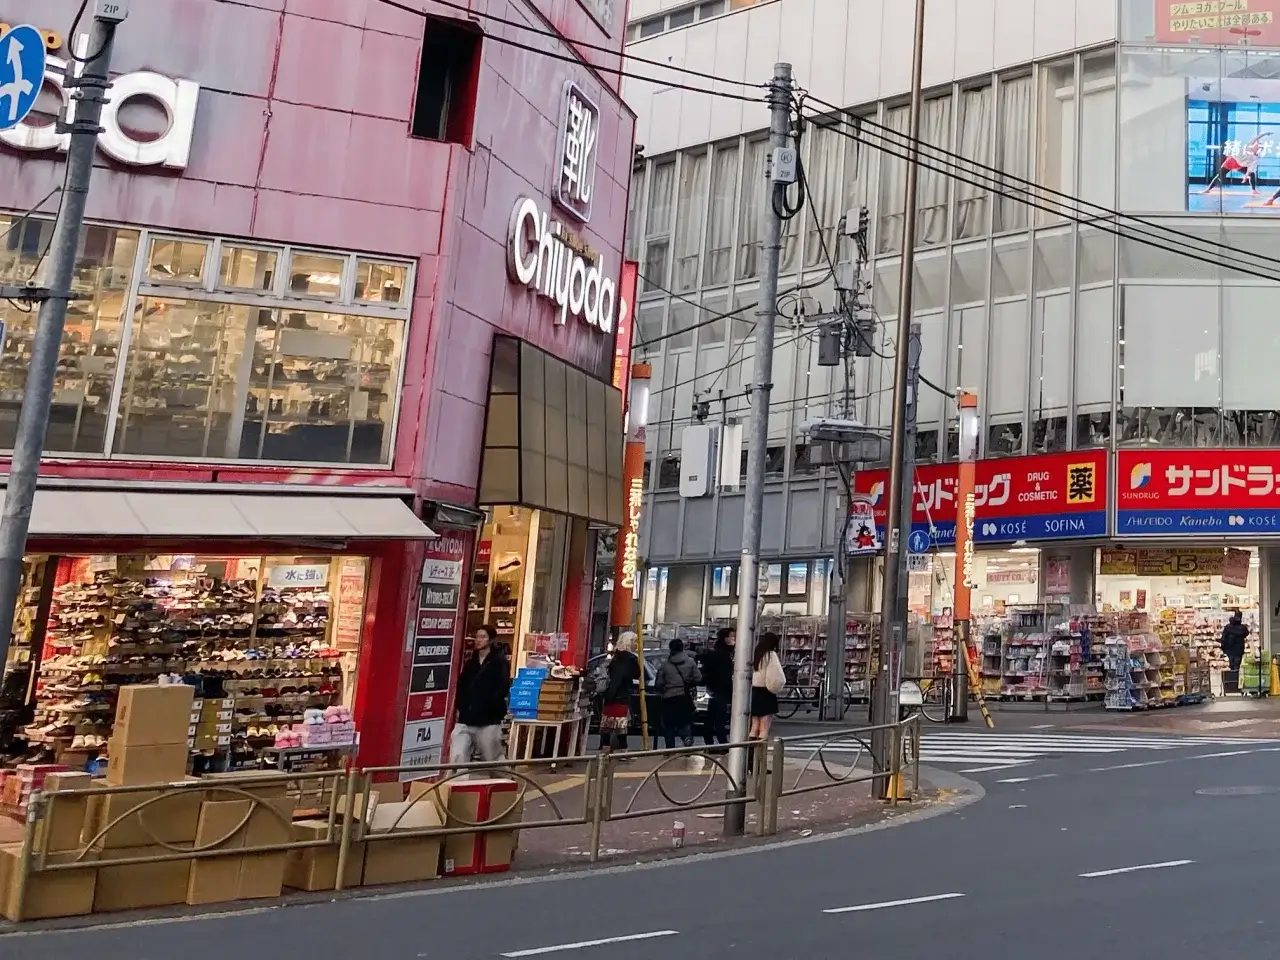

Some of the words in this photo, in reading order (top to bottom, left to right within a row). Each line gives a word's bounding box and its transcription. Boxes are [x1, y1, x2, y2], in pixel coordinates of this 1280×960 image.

[103, 3, 119, 14] ZIP
[563, 94, 595, 204] 靴
[511, 196, 616, 334] Chiyoda
[1027, 472, 1050, 482] DRUG
[1069, 467, 1093, 500] 薬
[1034, 482, 1041, 491] &
[1018, 490, 1058, 502] COSMETIC
[1000, 520, 1027, 534] KOSÉ
[1044, 519, 1085, 533] SOFINA
[1125, 516, 1173, 526] SHISEIDO
[1179, 516, 1223, 526] Kanebo
[1248, 515, 1277, 526] KOSÉ
[1165, 554, 1199, 573] 15
[284, 569, 324, 582] 水に強い
[417, 645, 450, 657] SKECHERS
[416, 726, 431, 743] FILA
